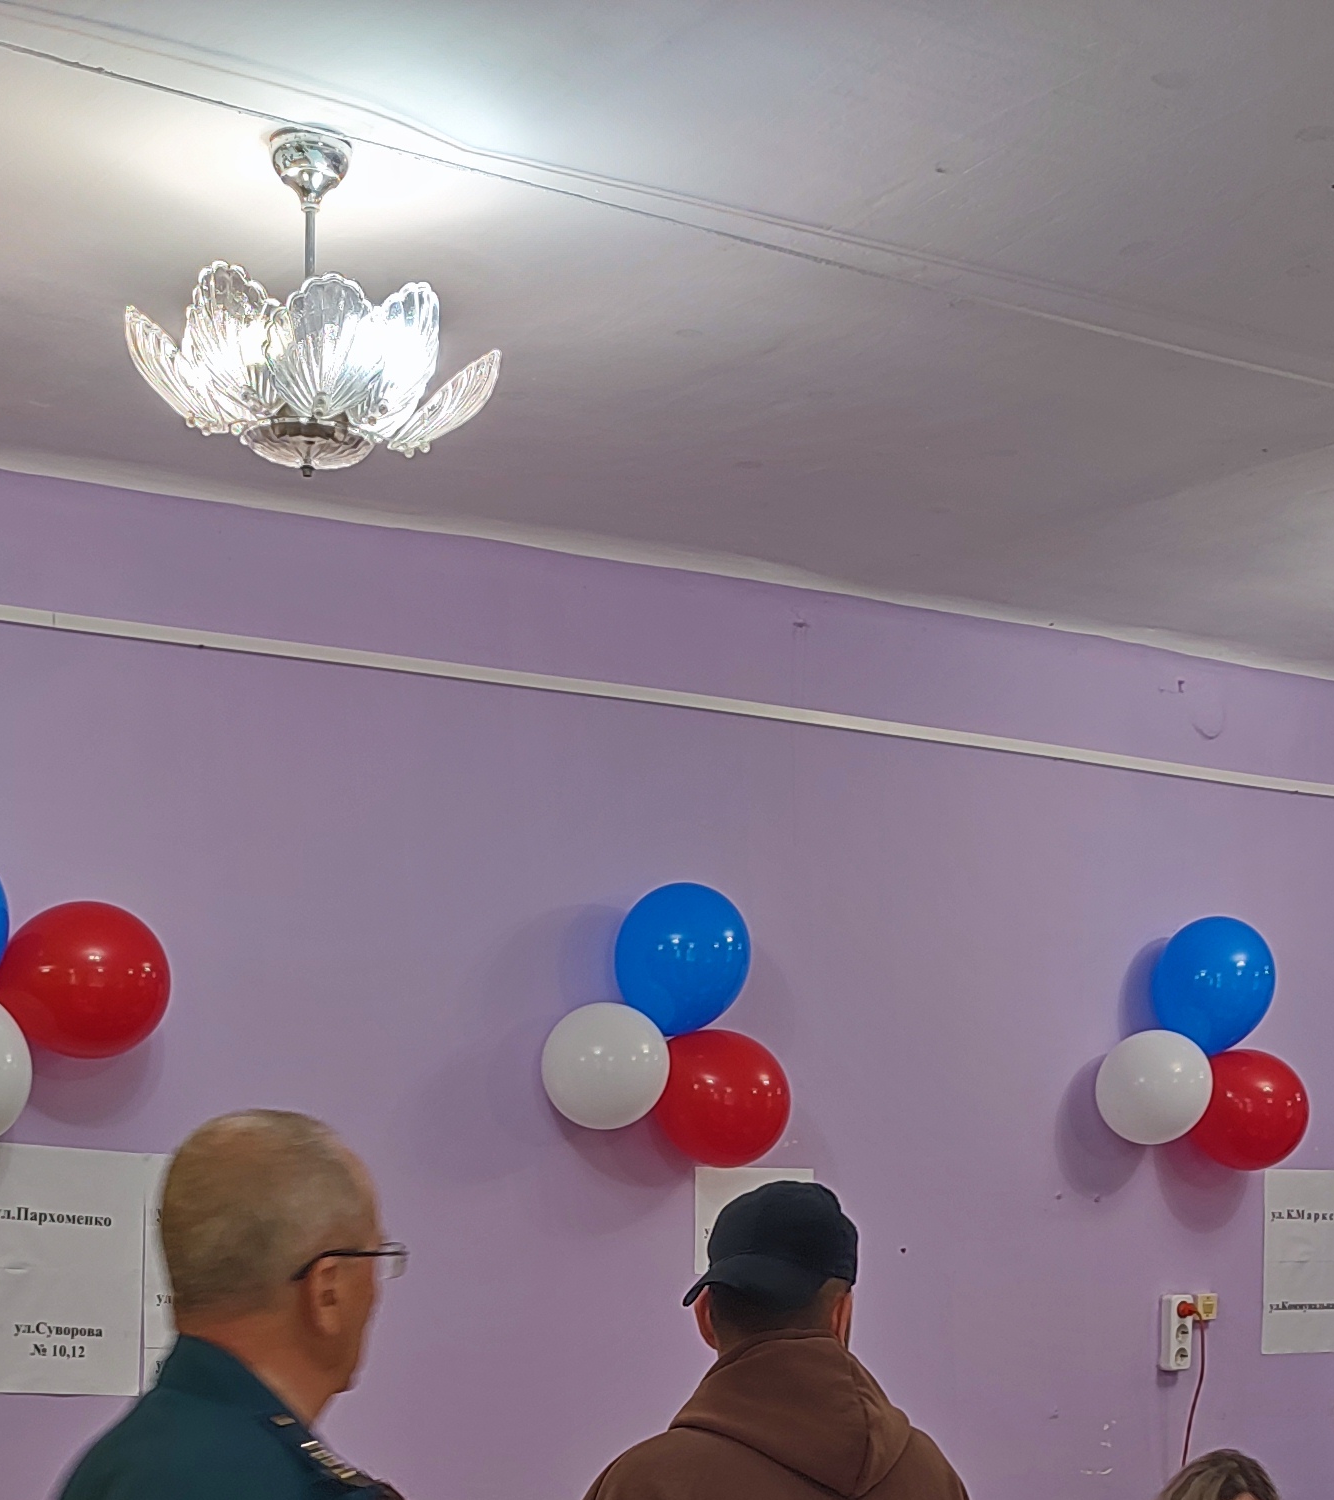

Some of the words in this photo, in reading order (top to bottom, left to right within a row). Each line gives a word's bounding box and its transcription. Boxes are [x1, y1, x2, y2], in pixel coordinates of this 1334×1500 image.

[14, 1321, 103, 1340] ул.Суворова
[29, 1343, 47, 1357] №
[52, 1344, 86, 1360] 10,12
